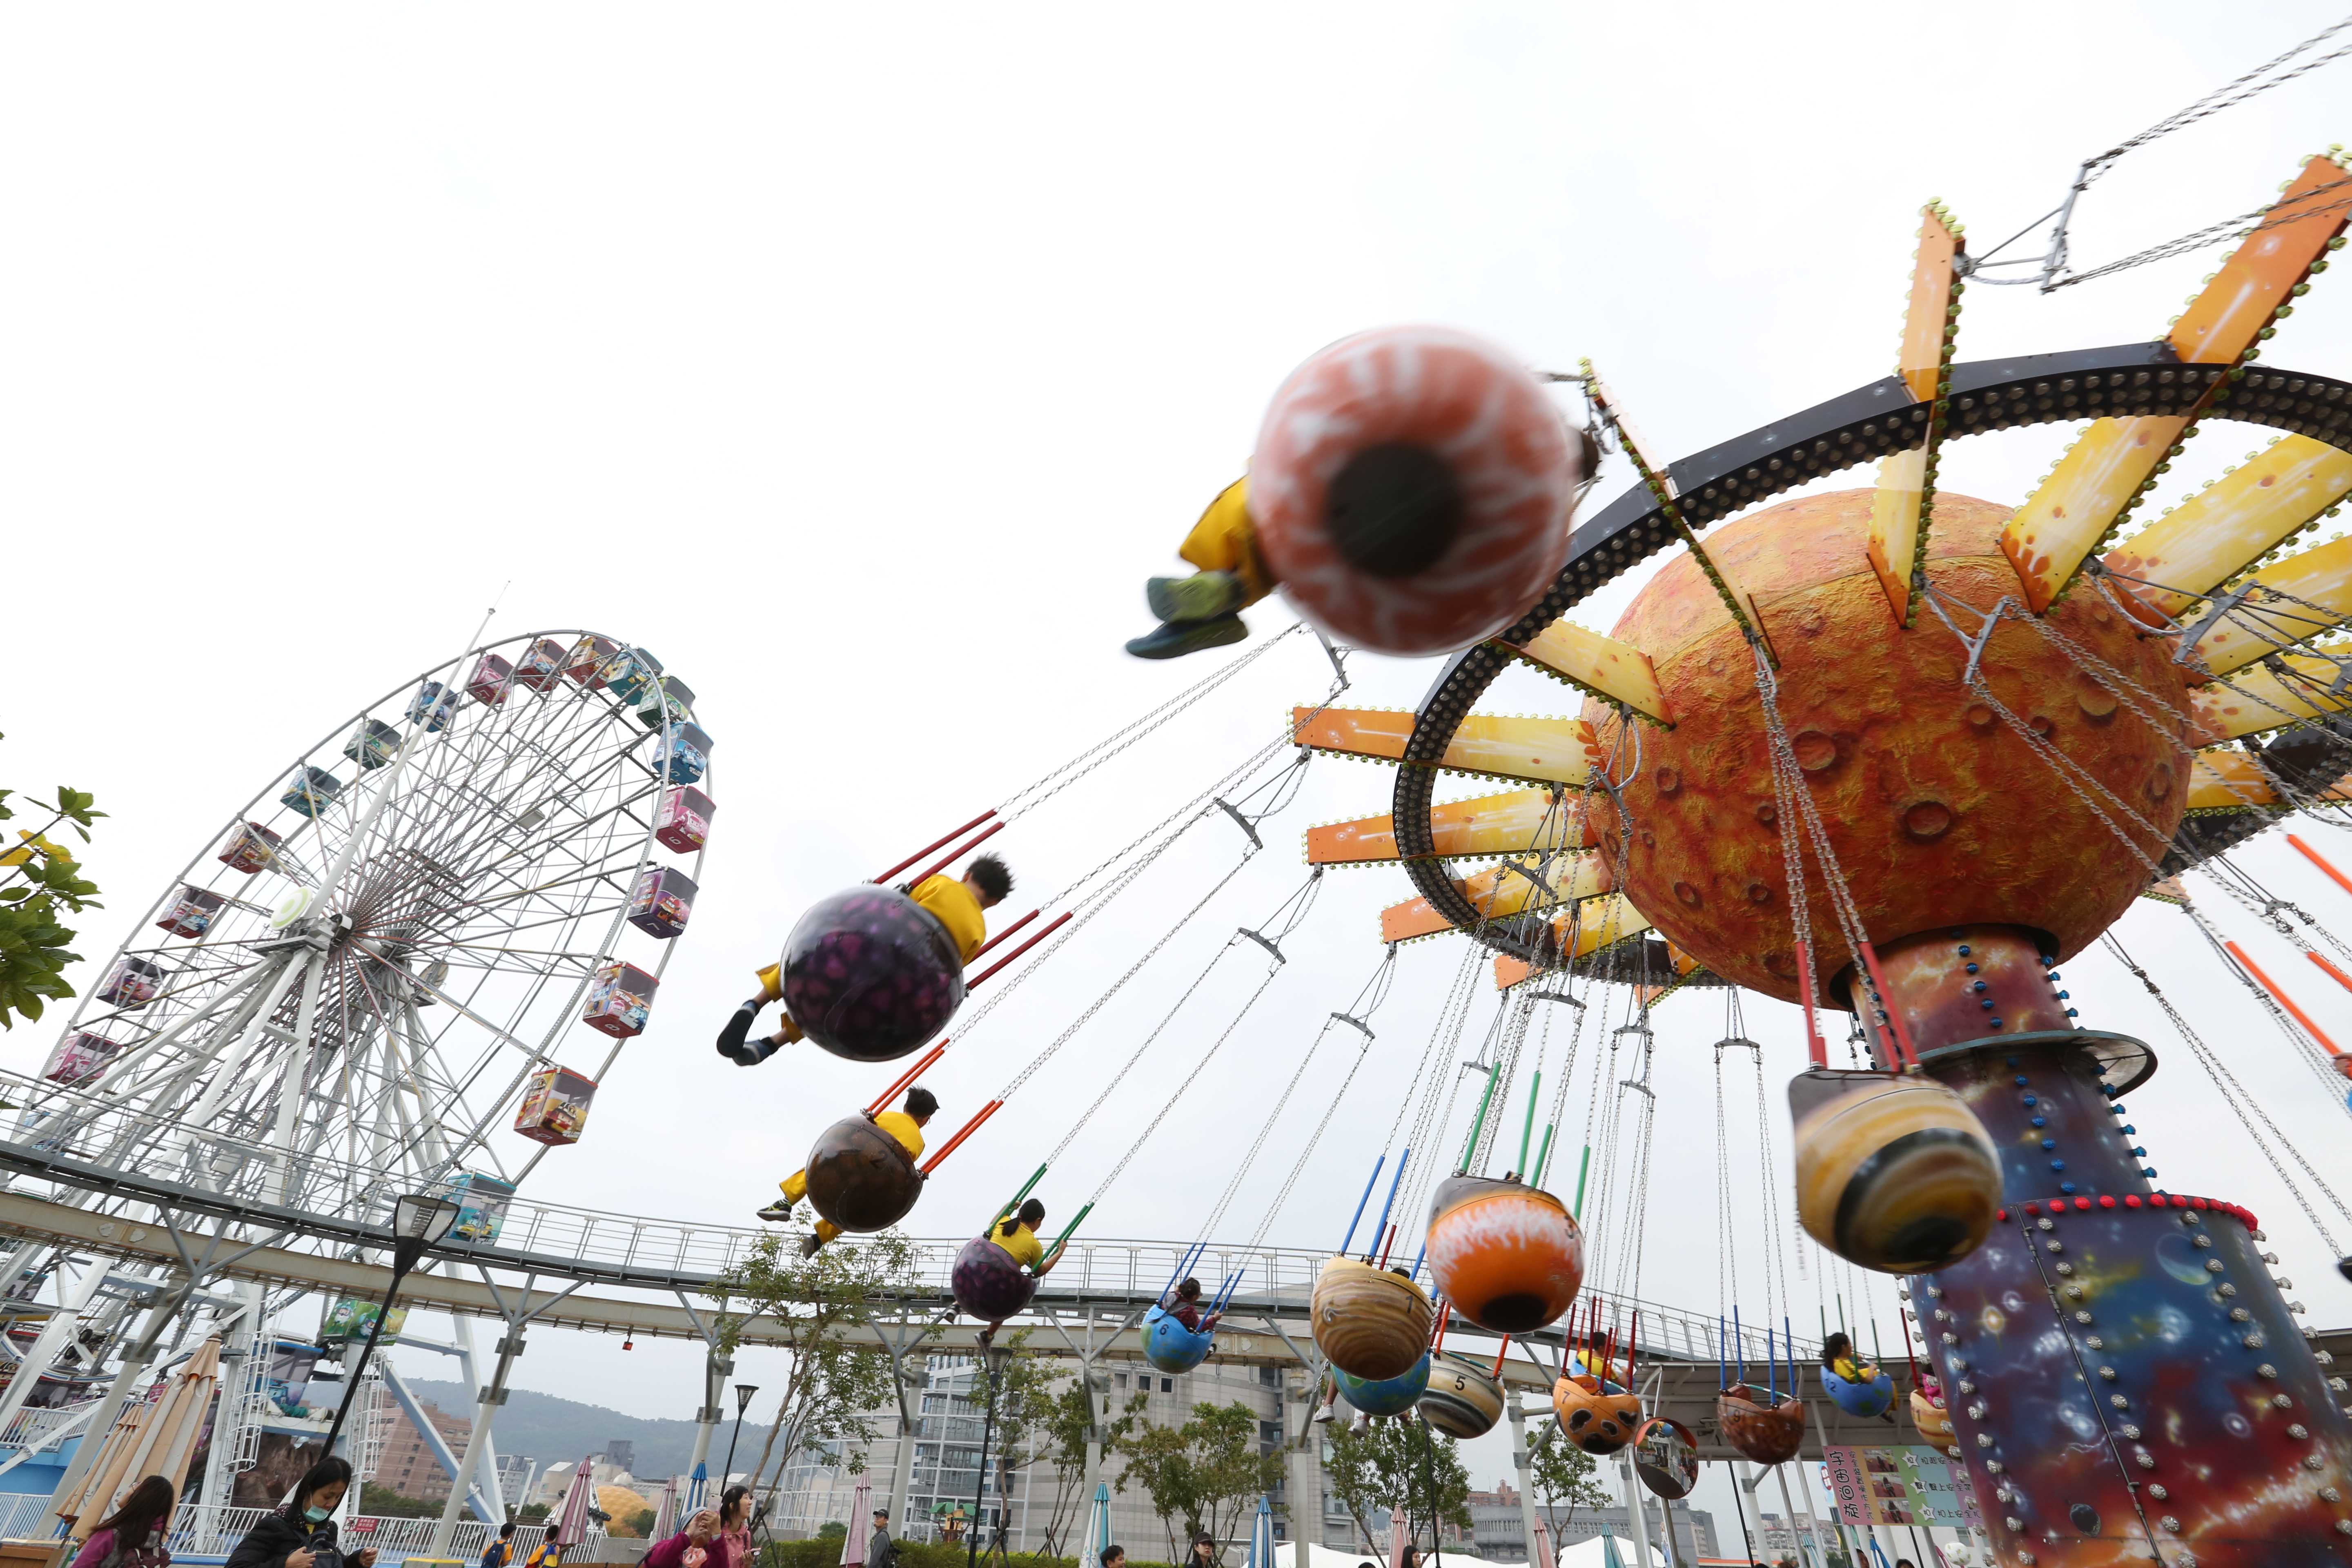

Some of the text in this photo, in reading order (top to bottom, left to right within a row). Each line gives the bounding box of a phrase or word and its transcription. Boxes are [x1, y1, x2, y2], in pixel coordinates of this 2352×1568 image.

[869, 1150, 888, 1169] 2
[1405, 1295, 1413, 1314] 1
[1160, 1324, 1169, 1335] 6
[1455, 1375, 1466, 1391] 5
[1562, 1390, 1570, 1404] 7
[1733, 1409, 1740, 1423] 9
